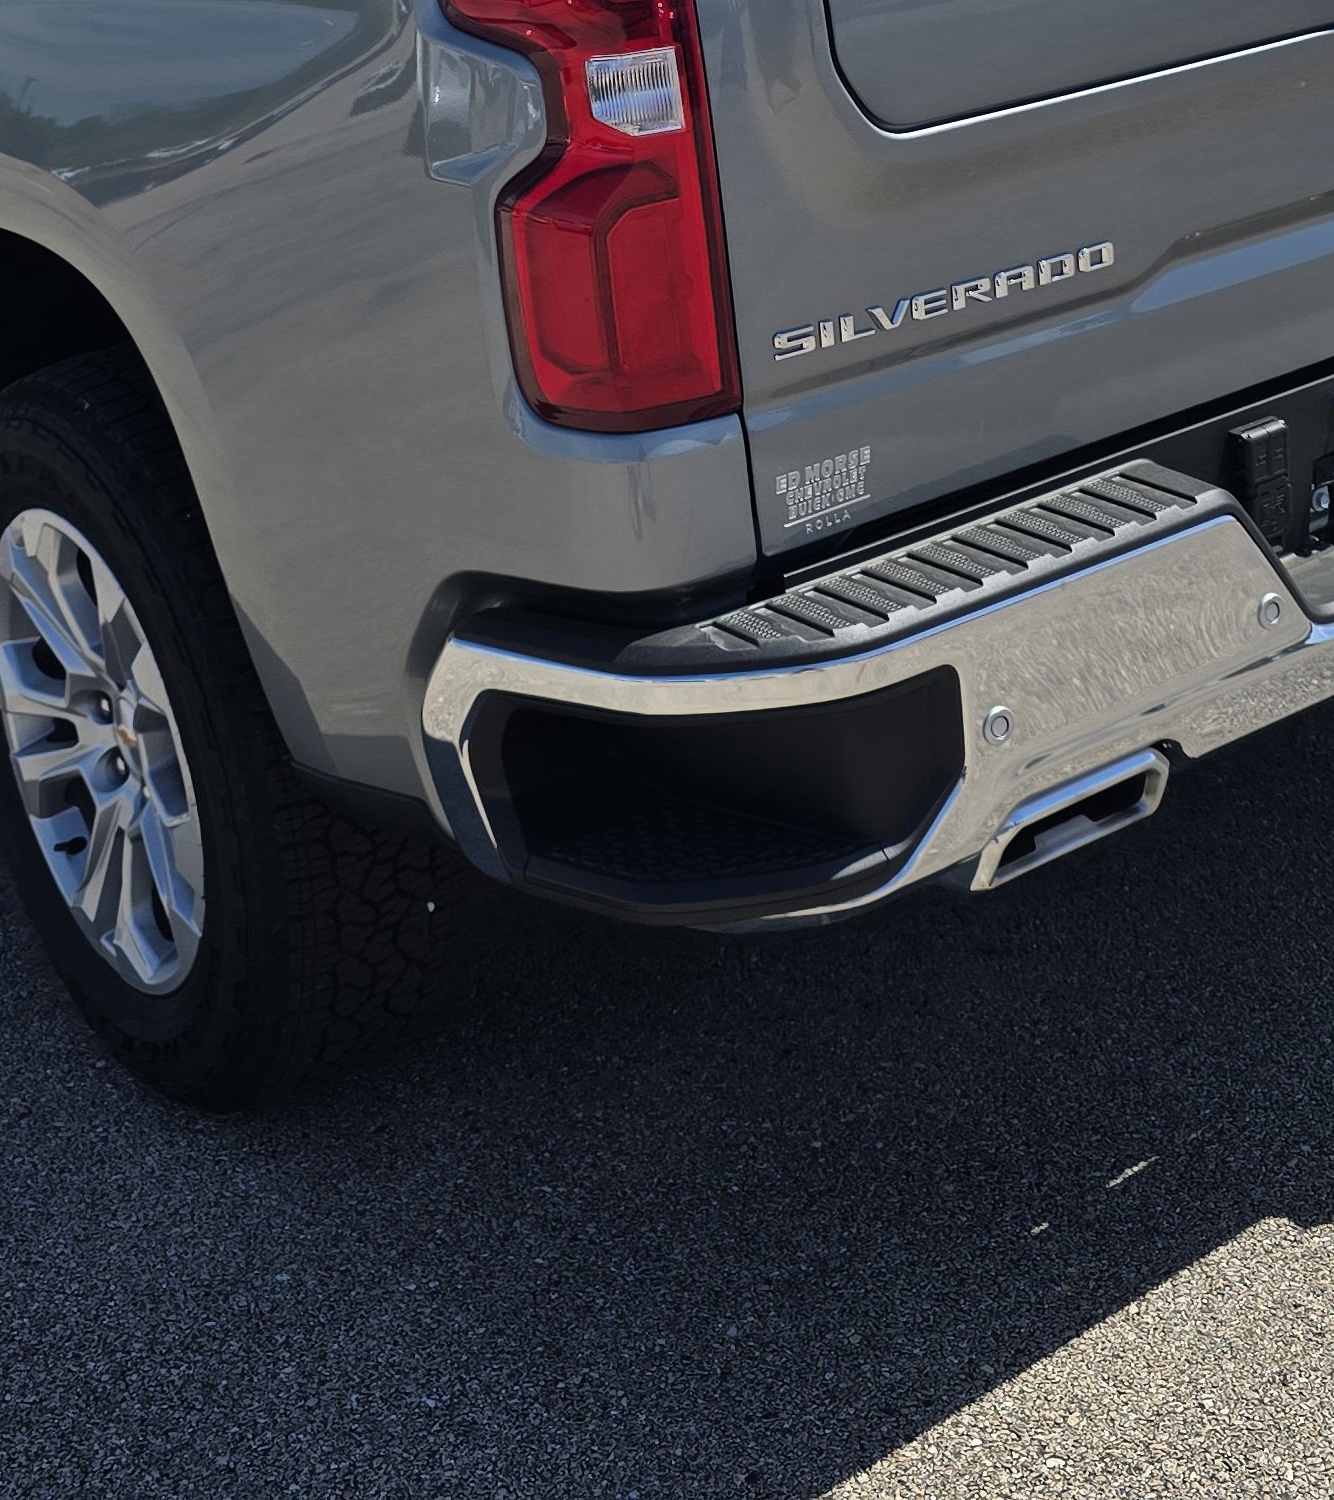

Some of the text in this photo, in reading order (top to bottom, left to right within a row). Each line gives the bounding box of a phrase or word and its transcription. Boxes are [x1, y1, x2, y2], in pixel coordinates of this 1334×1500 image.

[773, 241, 1115, 362] SILVERADO
[776, 445, 871, 495] ED MORSE
[786, 465, 867, 506] CHEVROLET
[806, 510, 851, 534] ROLLA
